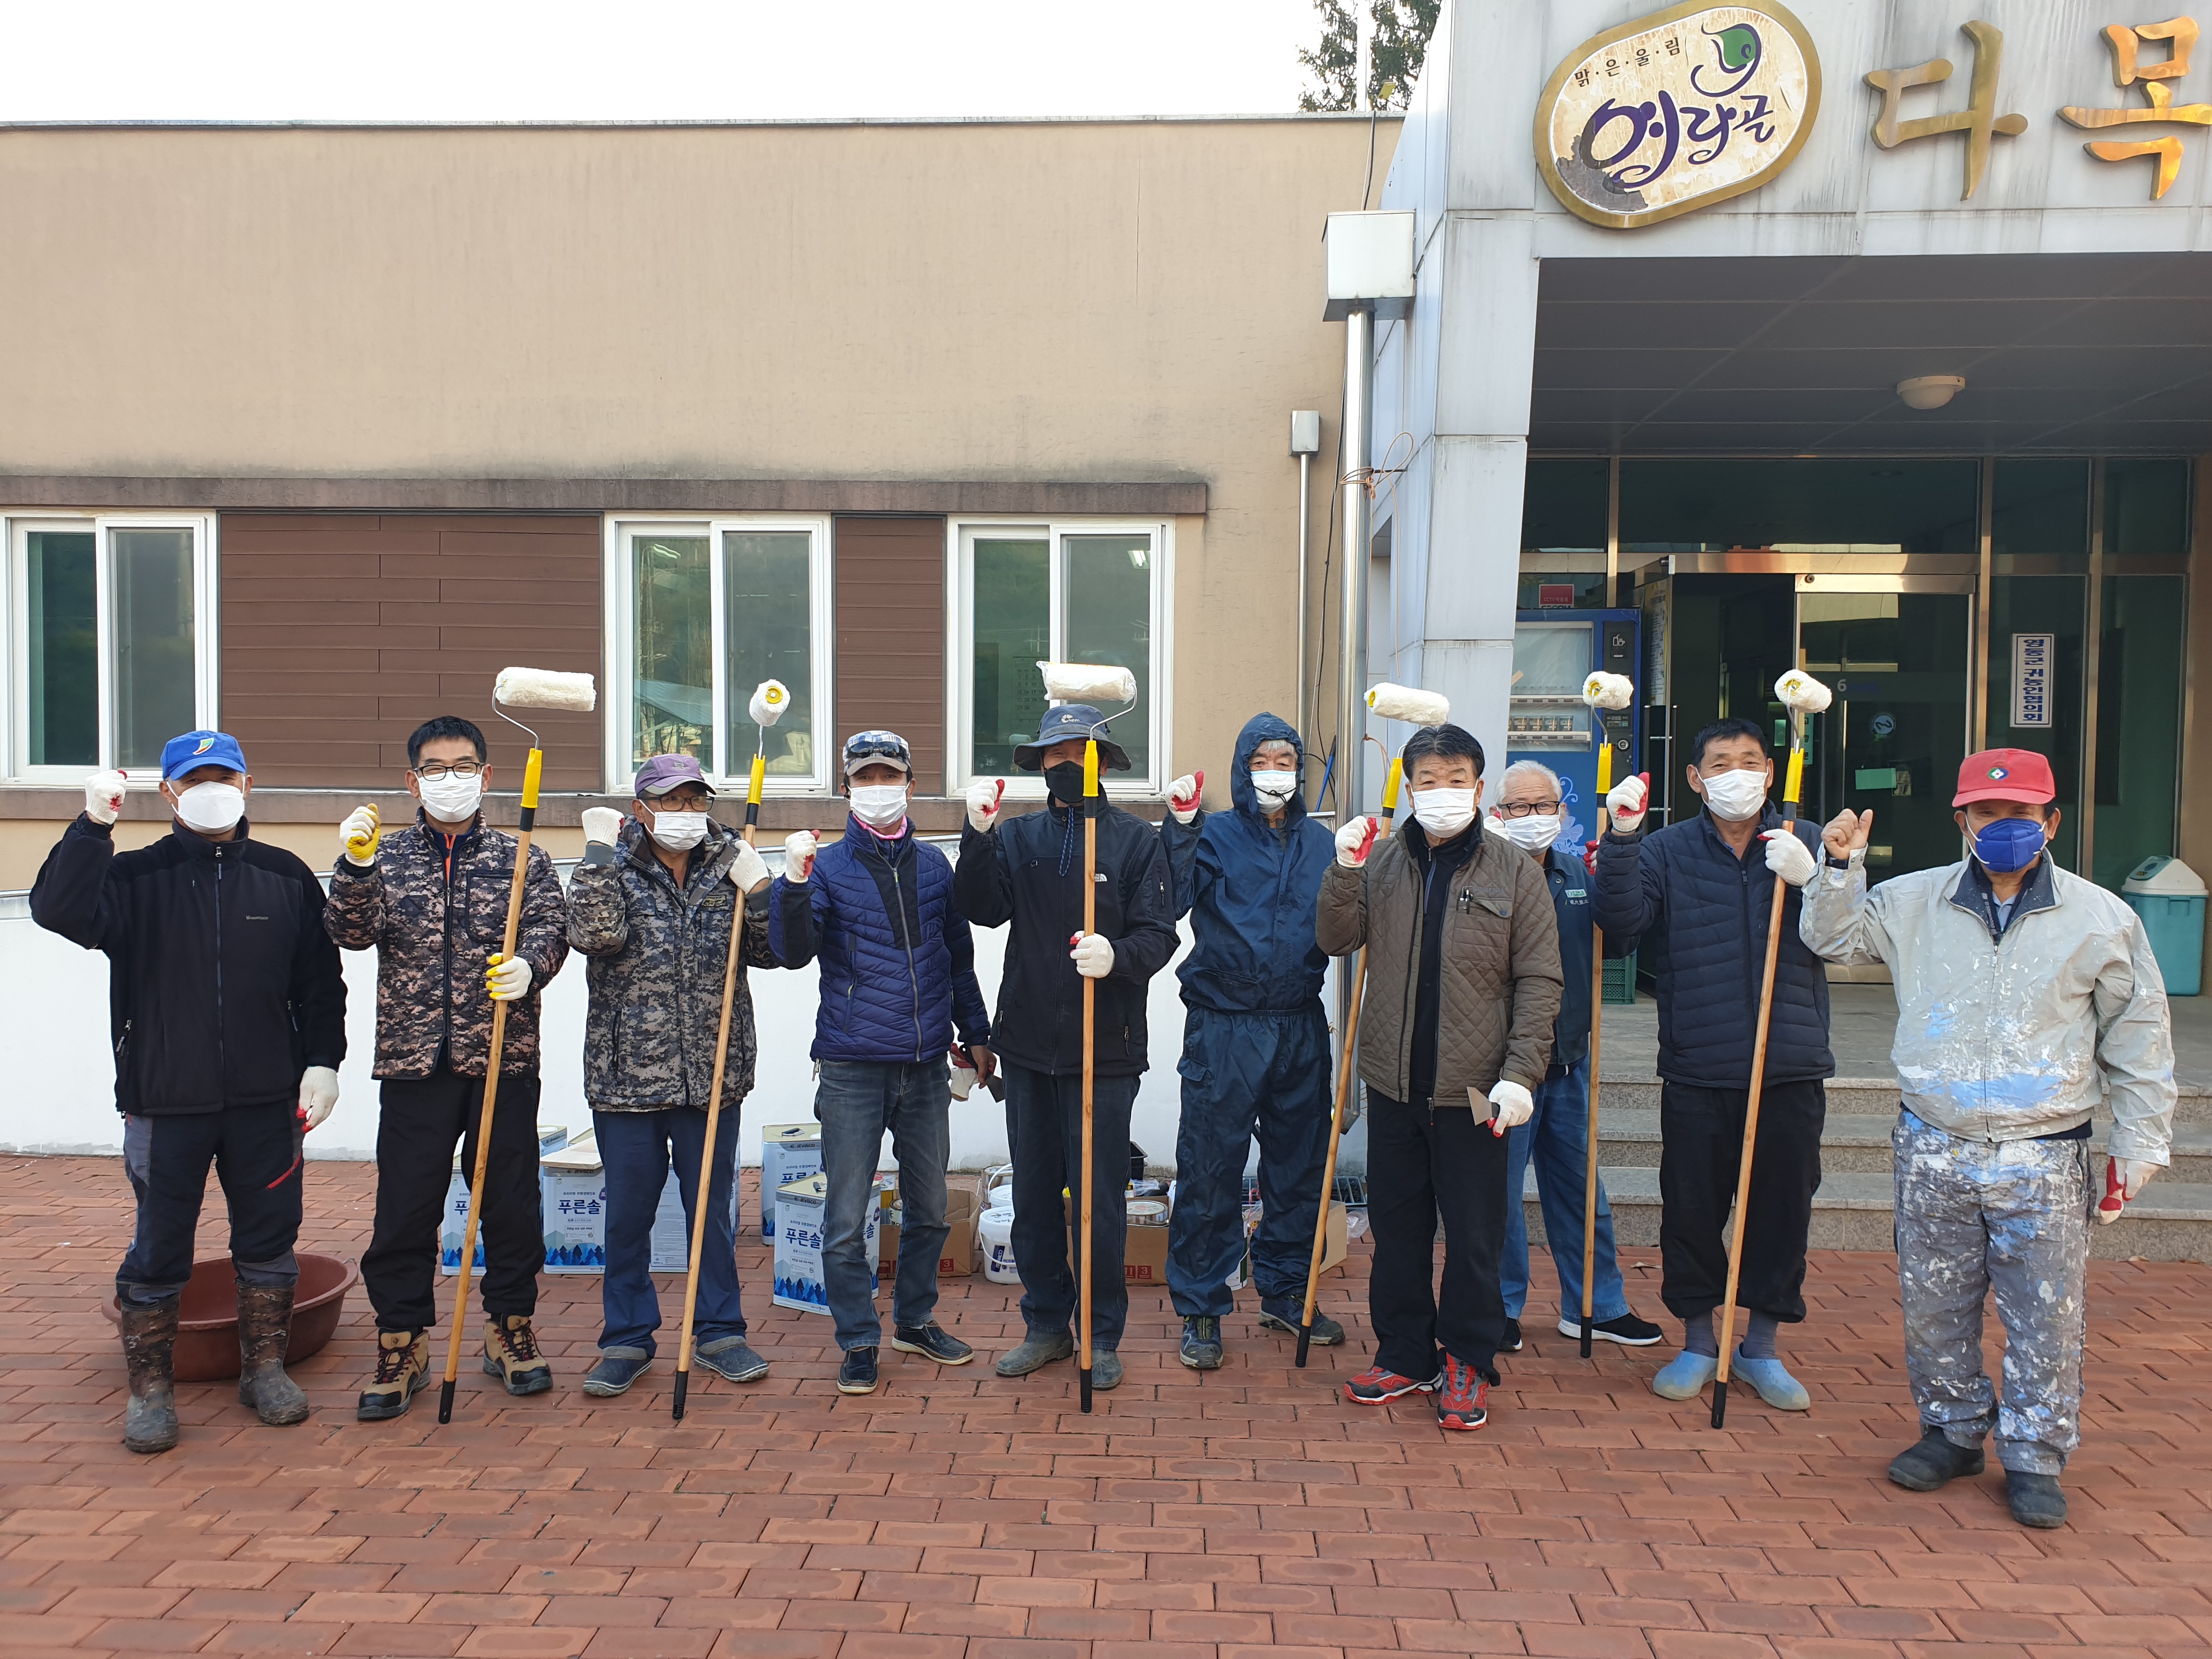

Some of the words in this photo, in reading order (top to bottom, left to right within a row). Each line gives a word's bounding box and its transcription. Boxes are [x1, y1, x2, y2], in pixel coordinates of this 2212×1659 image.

[1837, 679, 1847, 692] 6
[558, 1199, 601, 1215] 푸른솔
[785, 1227, 822, 1249] 푸른솔
[1141, 1266, 1148, 1274] 3
